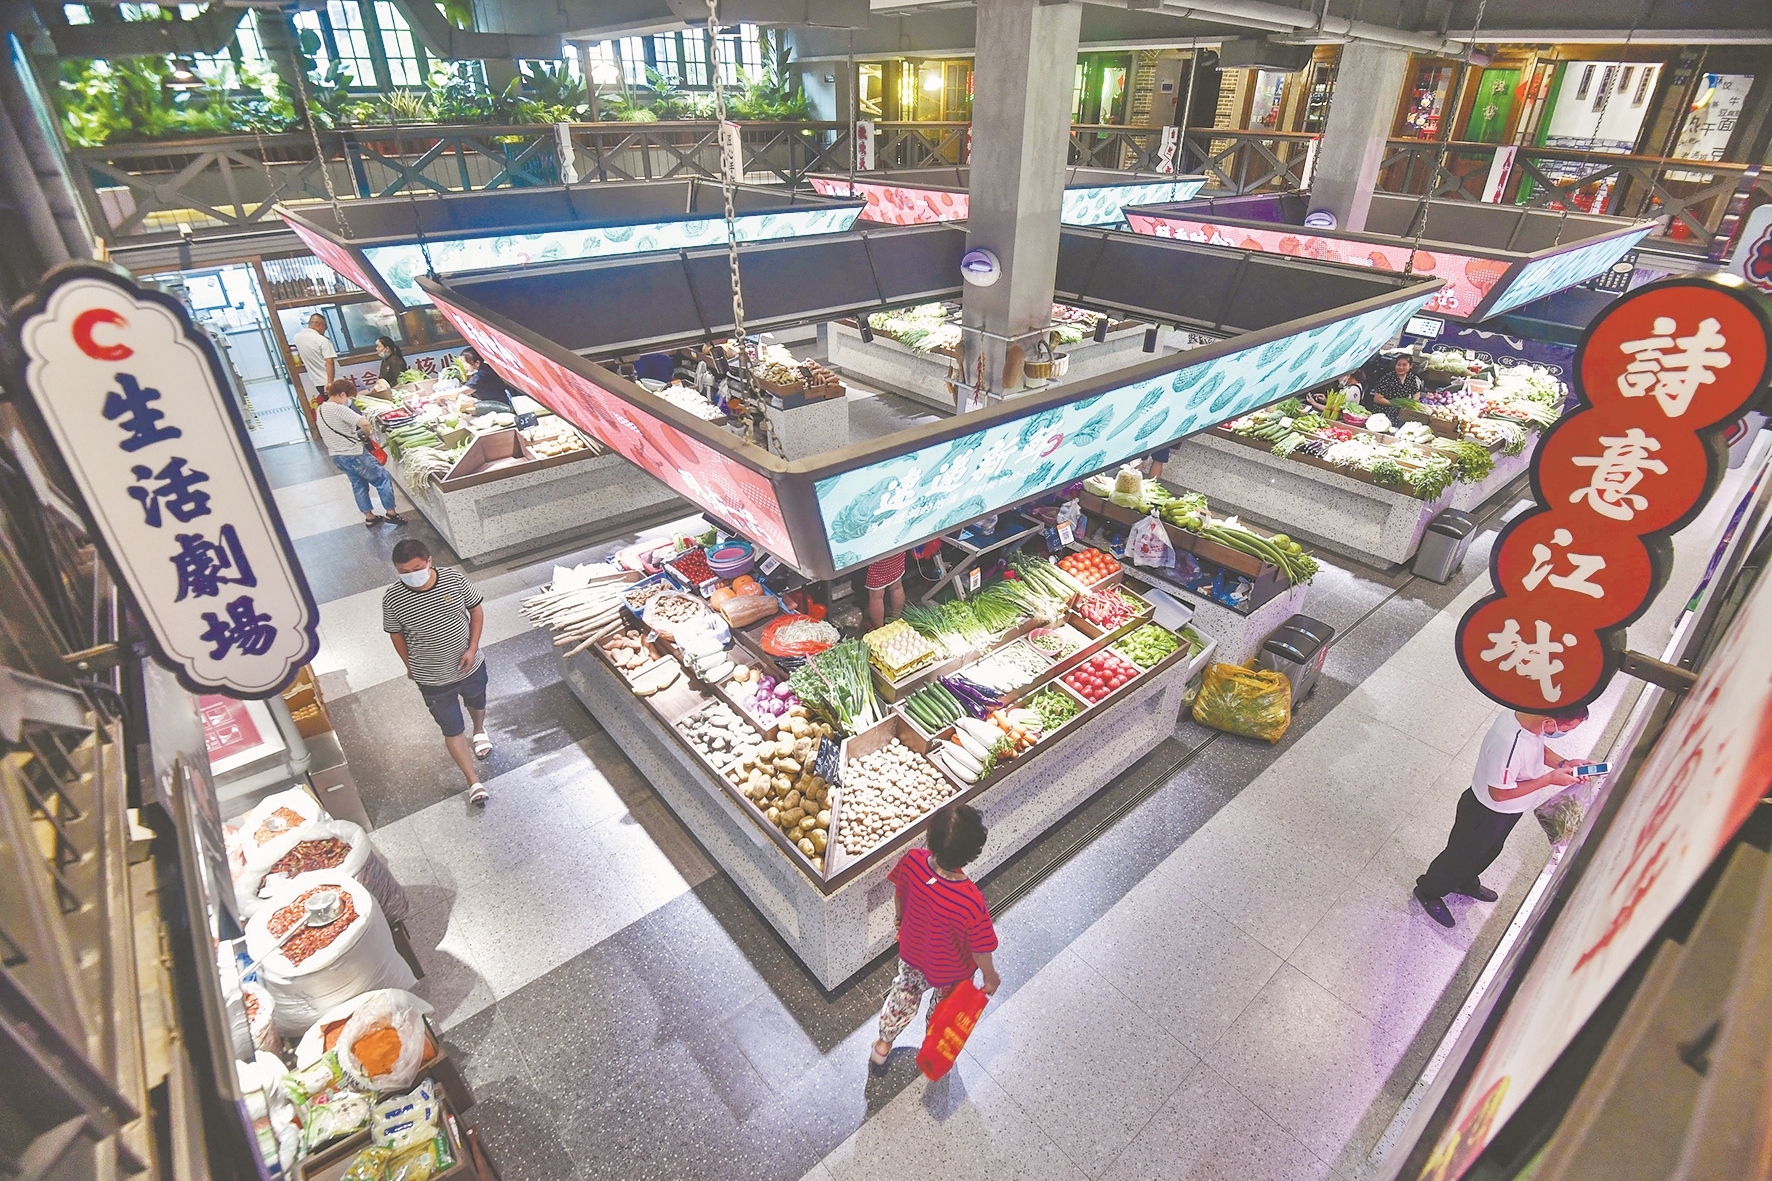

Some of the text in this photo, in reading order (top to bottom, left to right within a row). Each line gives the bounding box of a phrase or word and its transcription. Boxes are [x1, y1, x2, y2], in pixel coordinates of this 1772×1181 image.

[103, 373, 278, 660] 生活劇場
[1479, 317, 1731, 703] 詩意江城
